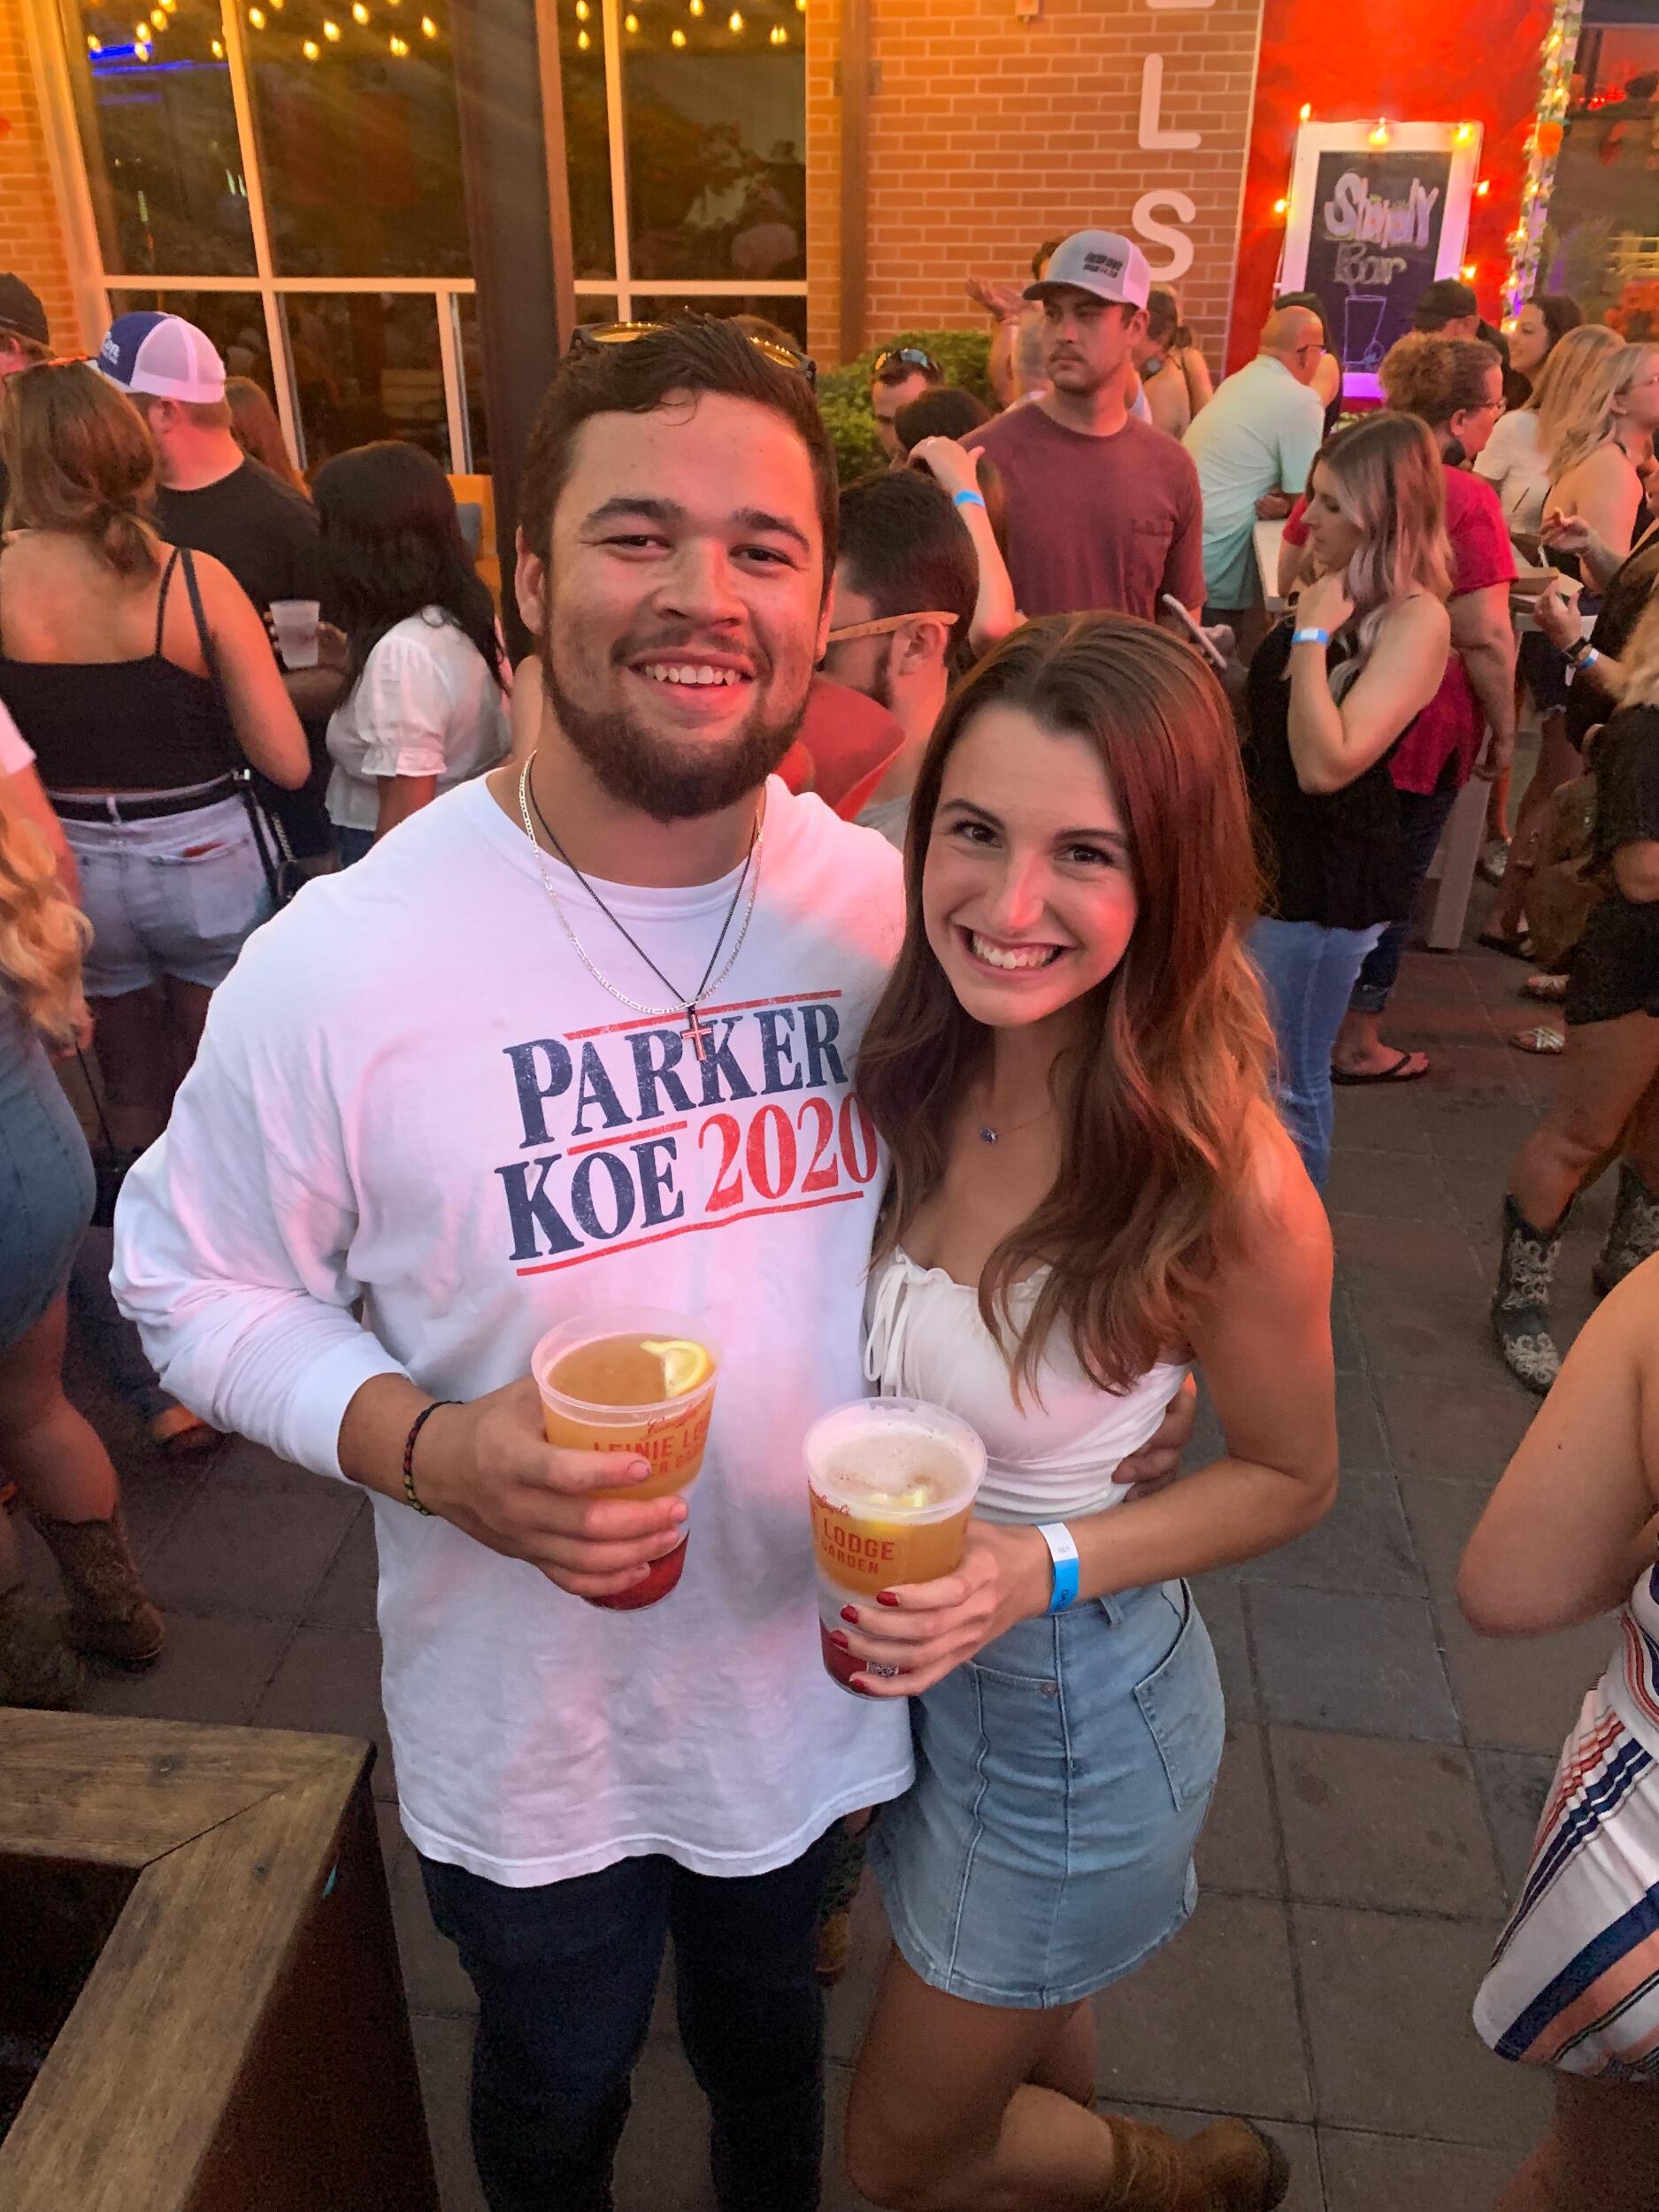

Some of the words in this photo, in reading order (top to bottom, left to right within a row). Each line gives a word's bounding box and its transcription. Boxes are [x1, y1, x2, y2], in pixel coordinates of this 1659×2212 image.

[1333, 242, 1407, 285] Bar
[503, 1003, 849, 1149] PARKER
[494, 1136, 685, 1261] KOE
[698, 1091, 879, 1213] 2020
[821, 1535, 879, 1574] GARDEN
[823, 1517, 895, 1560] LODGE
